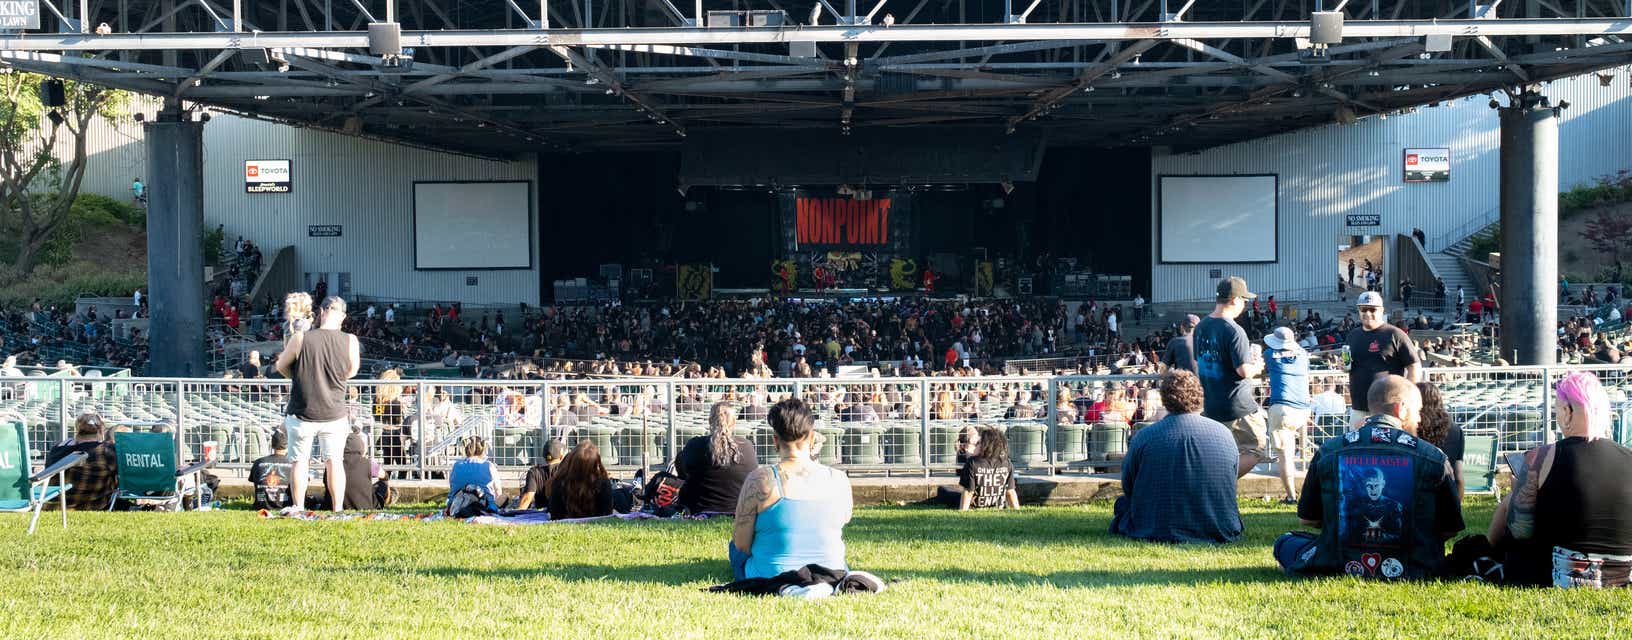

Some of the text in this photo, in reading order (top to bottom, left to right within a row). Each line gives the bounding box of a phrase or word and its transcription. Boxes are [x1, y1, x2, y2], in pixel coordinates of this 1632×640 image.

[3, 17, 27, 26] LAWN
[796, 198, 891, 244] NONPOINT
[125, 452, 165, 468] RENTAL
[1344, 455, 1409, 467] HELLRAISER
[977, 466, 986, 474] OH
[975, 472, 1010, 487] THEY
